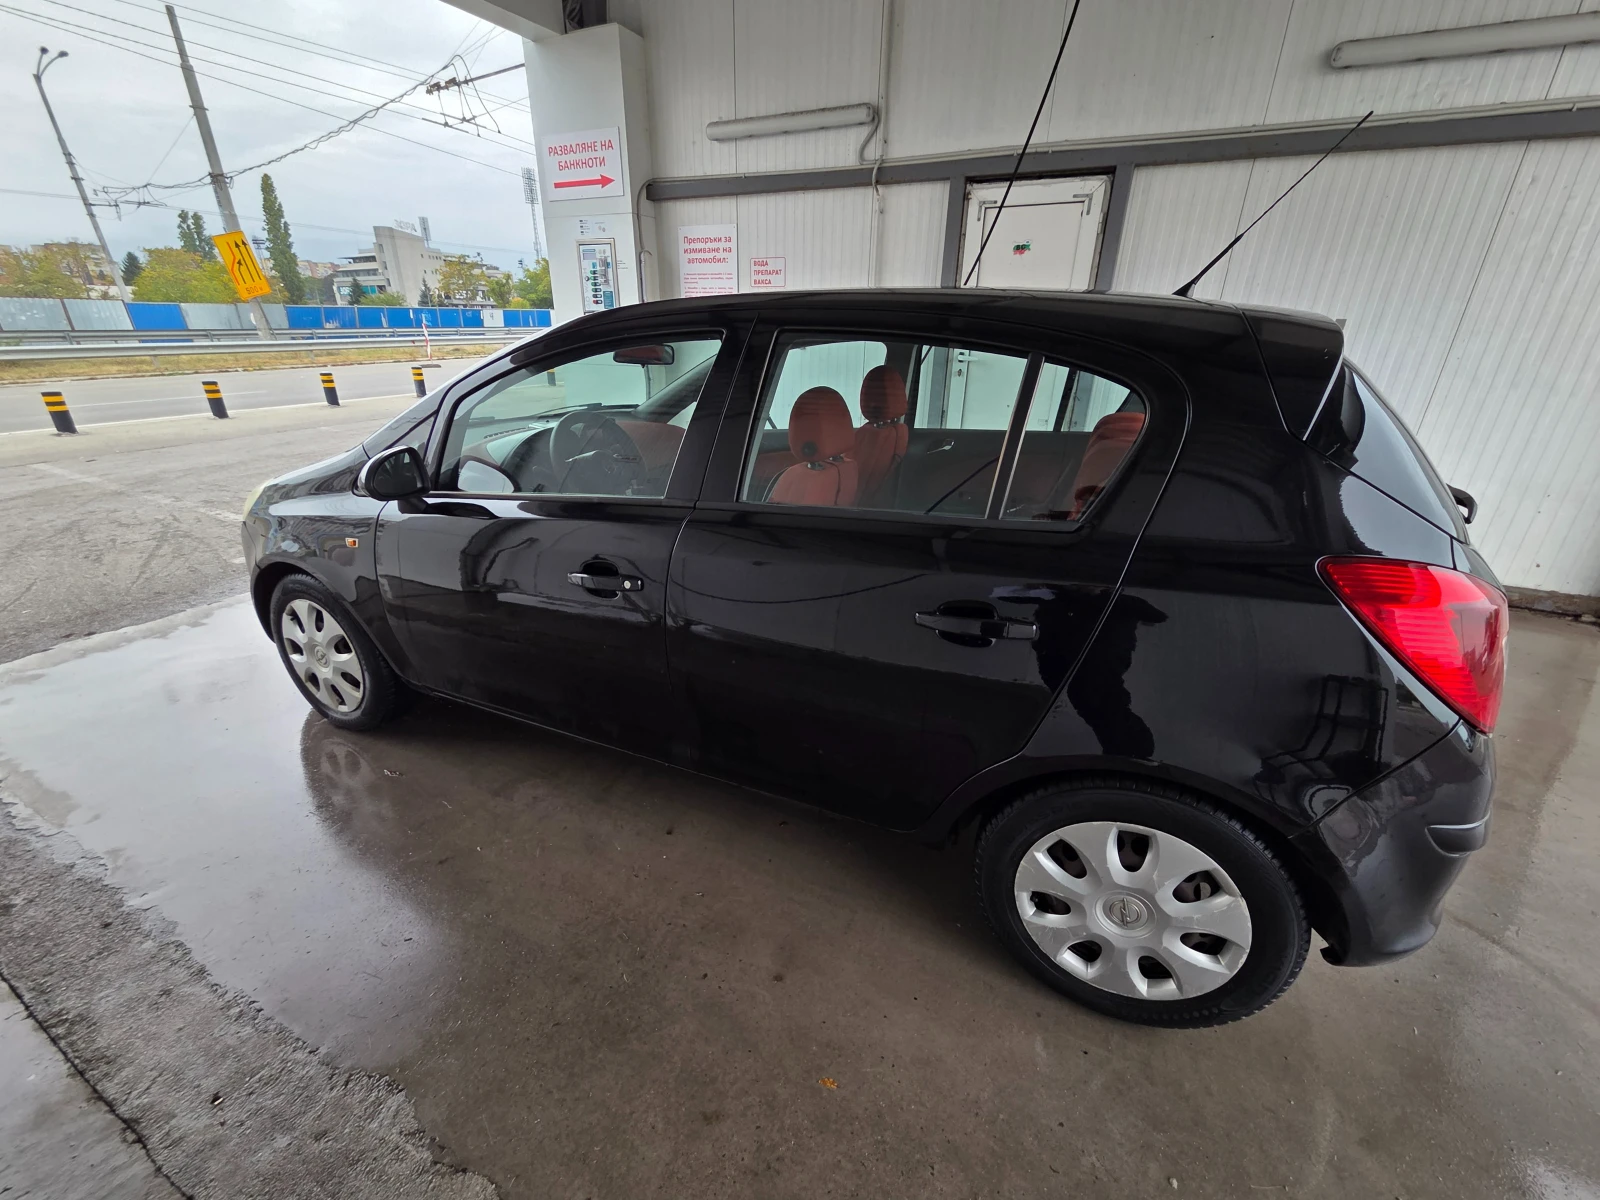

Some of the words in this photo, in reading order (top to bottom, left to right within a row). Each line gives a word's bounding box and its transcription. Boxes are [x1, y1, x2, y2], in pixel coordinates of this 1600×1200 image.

[548, 141, 598, 157] РАЗВАЛЯНЕ
[600, 139, 614, 152] НА
[558, 156, 606, 171] БАНКНОТИ
[683, 236, 722, 246] Препоръки
[687, 255, 729, 264] автомобил:
[245, 285, 259, 295] 500
